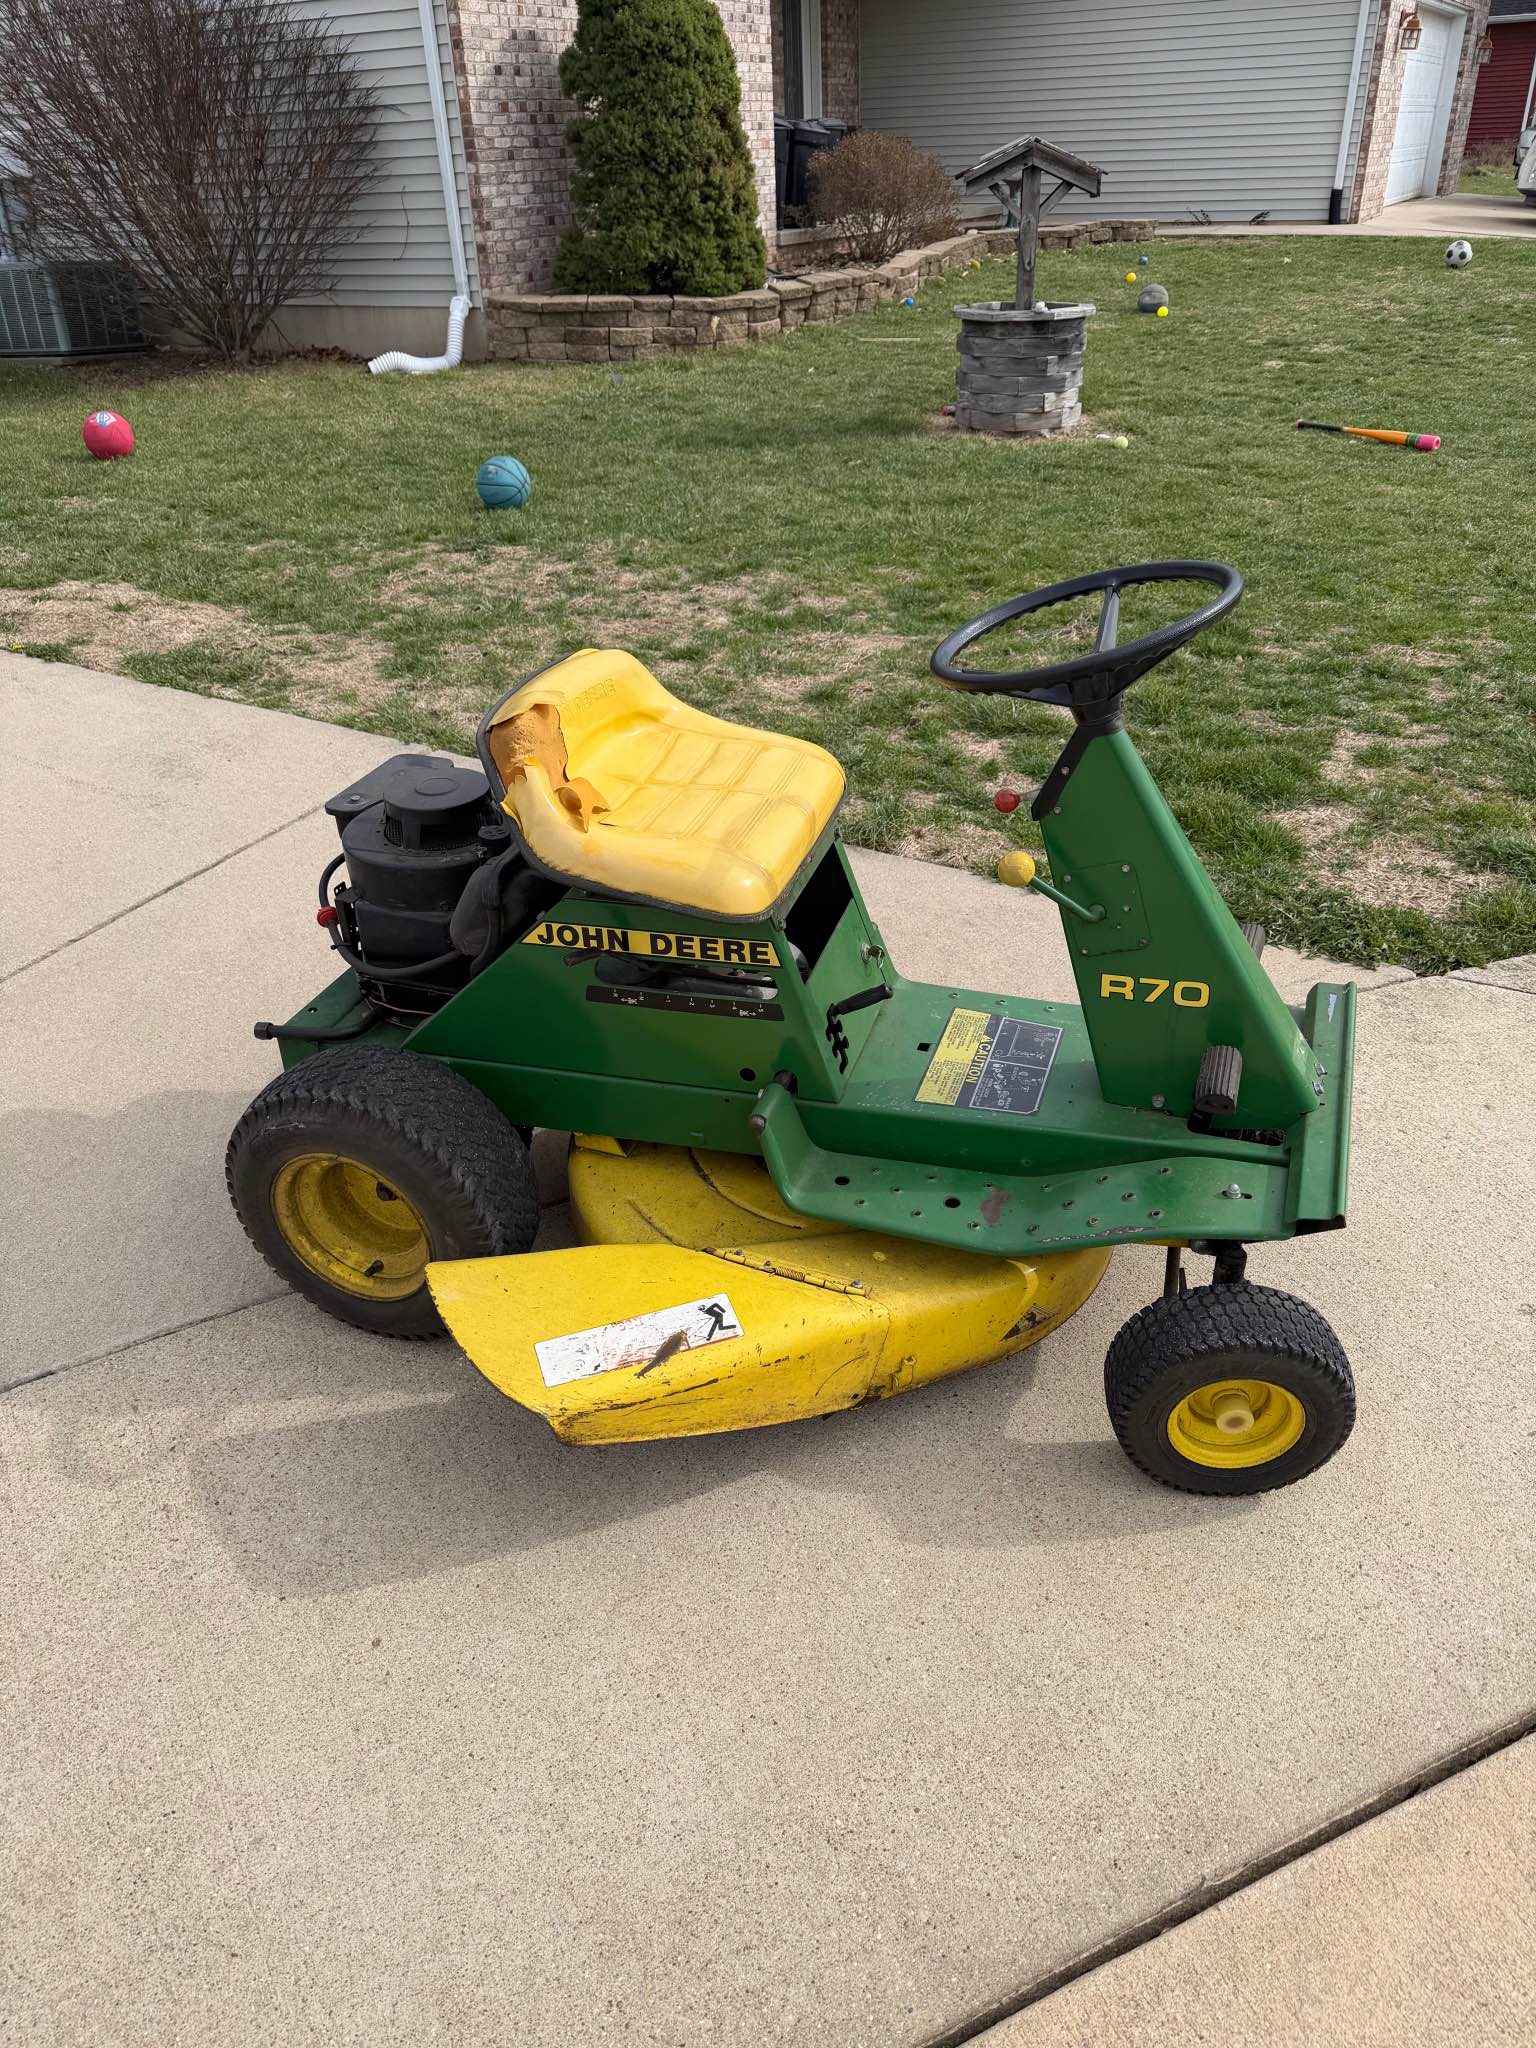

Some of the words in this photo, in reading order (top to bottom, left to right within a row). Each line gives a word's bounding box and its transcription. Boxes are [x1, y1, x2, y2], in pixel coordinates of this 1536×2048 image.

[537, 923, 630, 951] JOHN
[649, 933, 771, 964] DEERE
[1100, 973, 1210, 1008] R70
[966, 1043, 991, 1083] CAUTION
